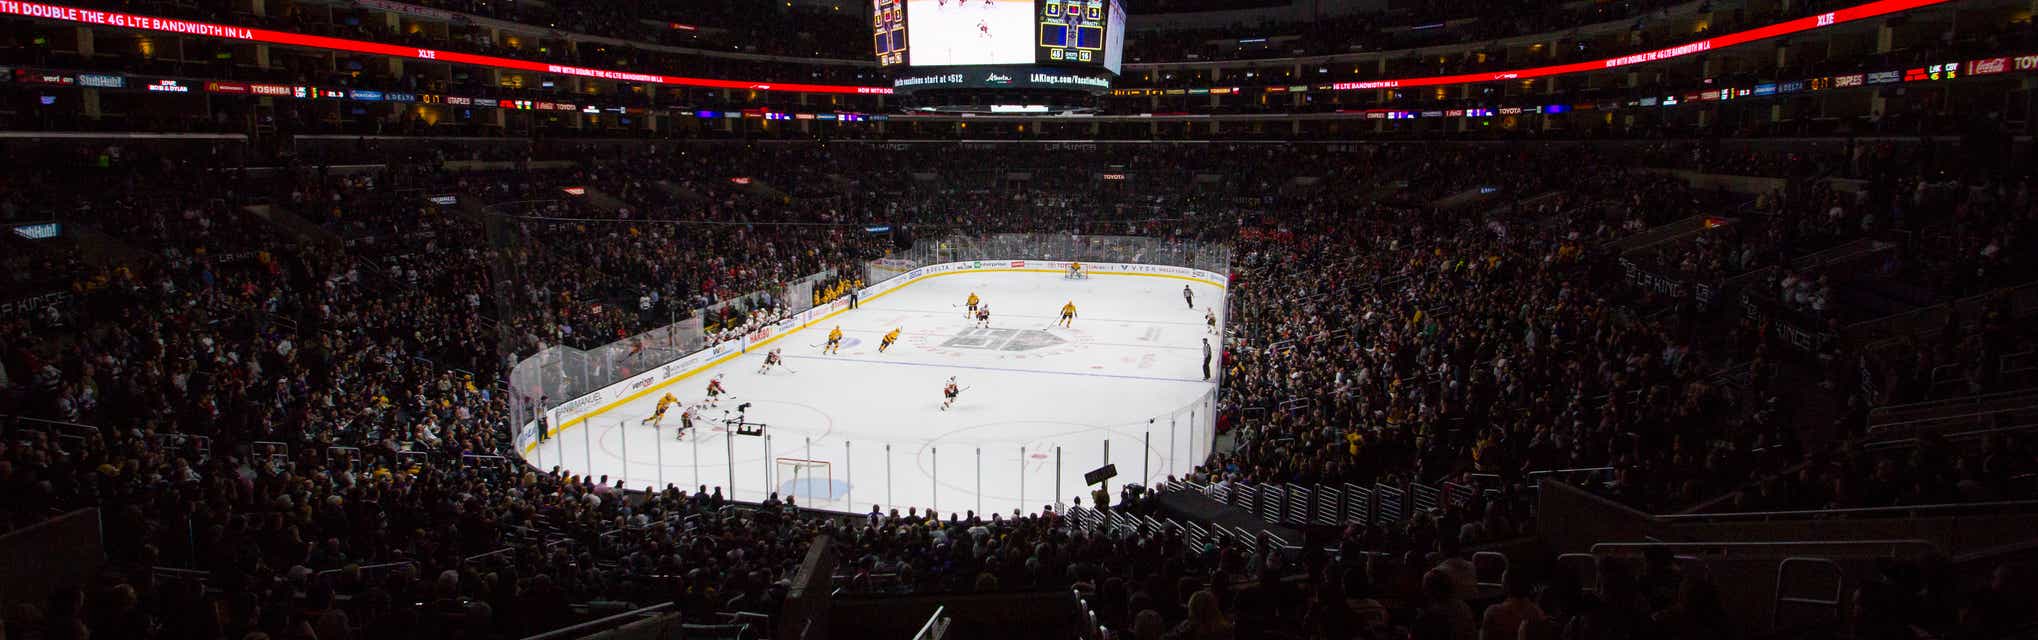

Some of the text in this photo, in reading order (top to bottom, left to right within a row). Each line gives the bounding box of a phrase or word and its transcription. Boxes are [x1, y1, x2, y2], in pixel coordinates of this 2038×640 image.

[22, 3, 77, 20] DOUBLE
[80, 10, 105, 24] THE
[107, 14, 124, 26] 4G
[128, 16, 149, 28] LTE
[153, 19, 222, 36] BANDWIDTH
[225, 27, 236, 37] IN
[239, 29, 253, 39] LA
[1817, 12, 1835, 26] XLTE
[1704, 40, 1711, 49] LA
[418, 49, 436, 59] XLTE
[925, 74, 938, 84] start
[1834, 75, 1862, 87] STAPLES
[251, 84, 291, 95] TOSHIBA
